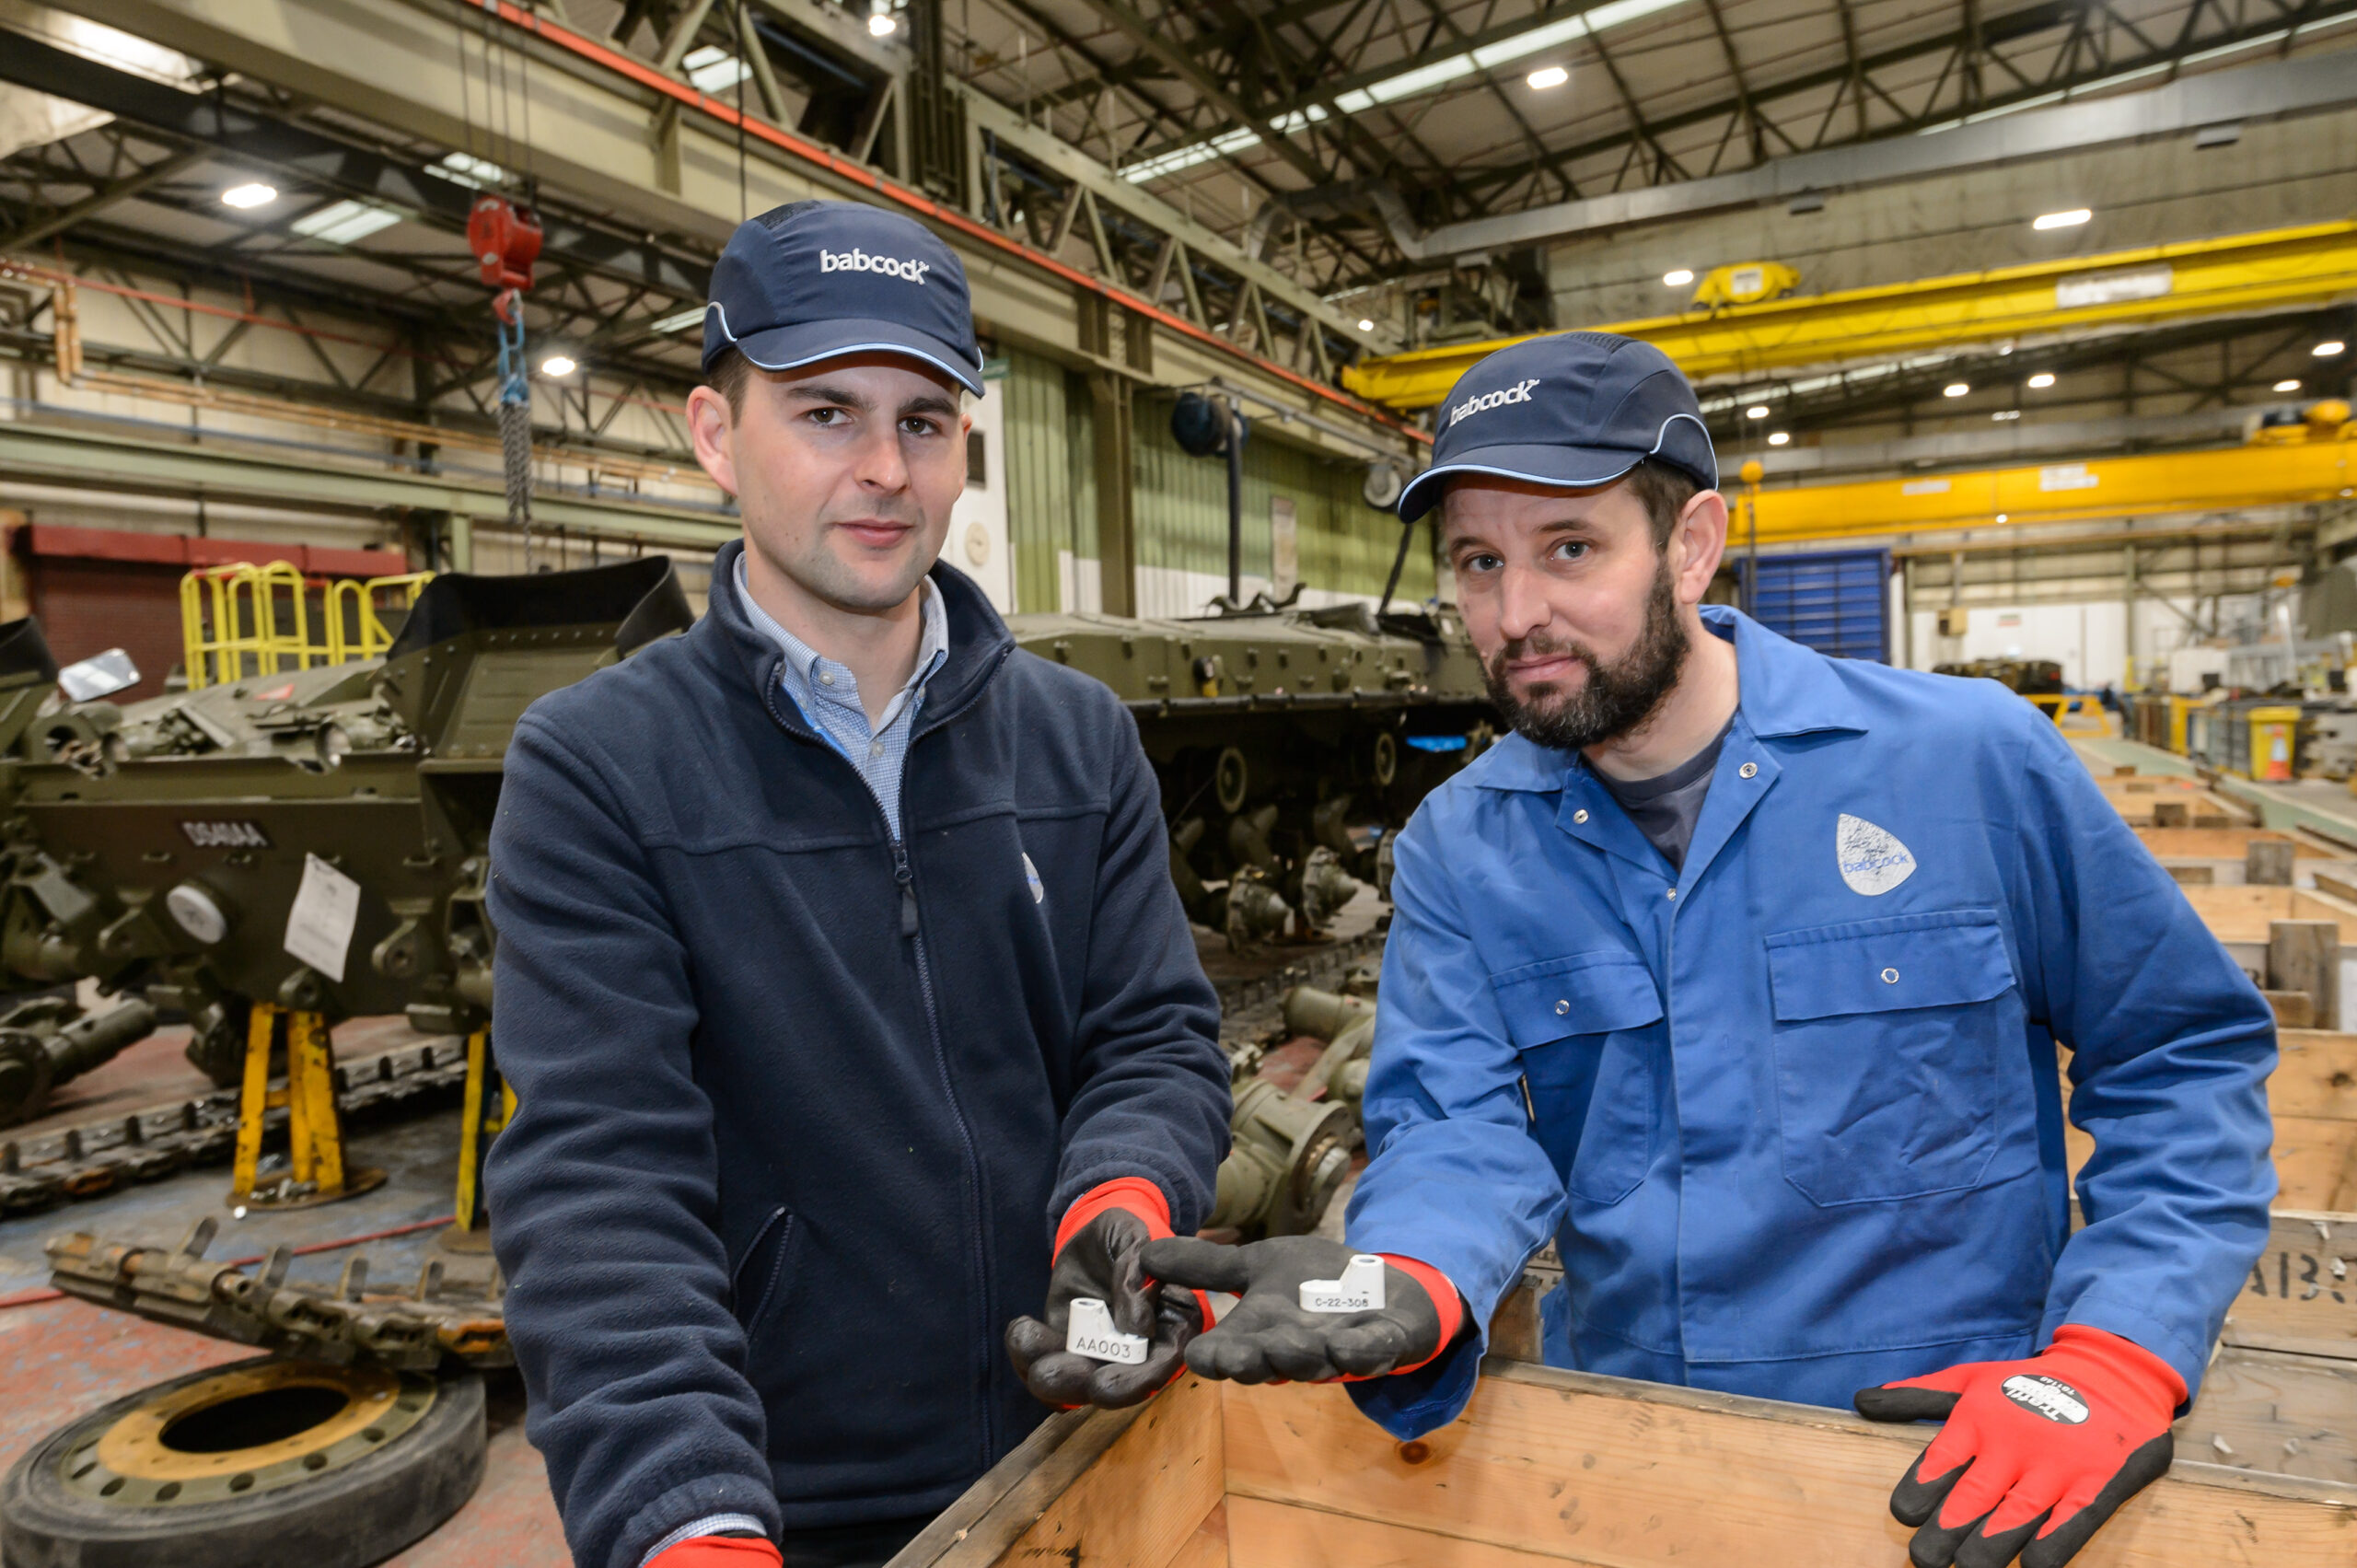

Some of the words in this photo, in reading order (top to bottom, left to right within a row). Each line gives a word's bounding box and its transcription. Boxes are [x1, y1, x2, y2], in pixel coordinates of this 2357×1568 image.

[819, 248, 930, 285] babcock
[1449, 378, 1540, 428] babcock
[1842, 851, 1909, 874] babcock
[1075, 1336, 1132, 1359] AA003
